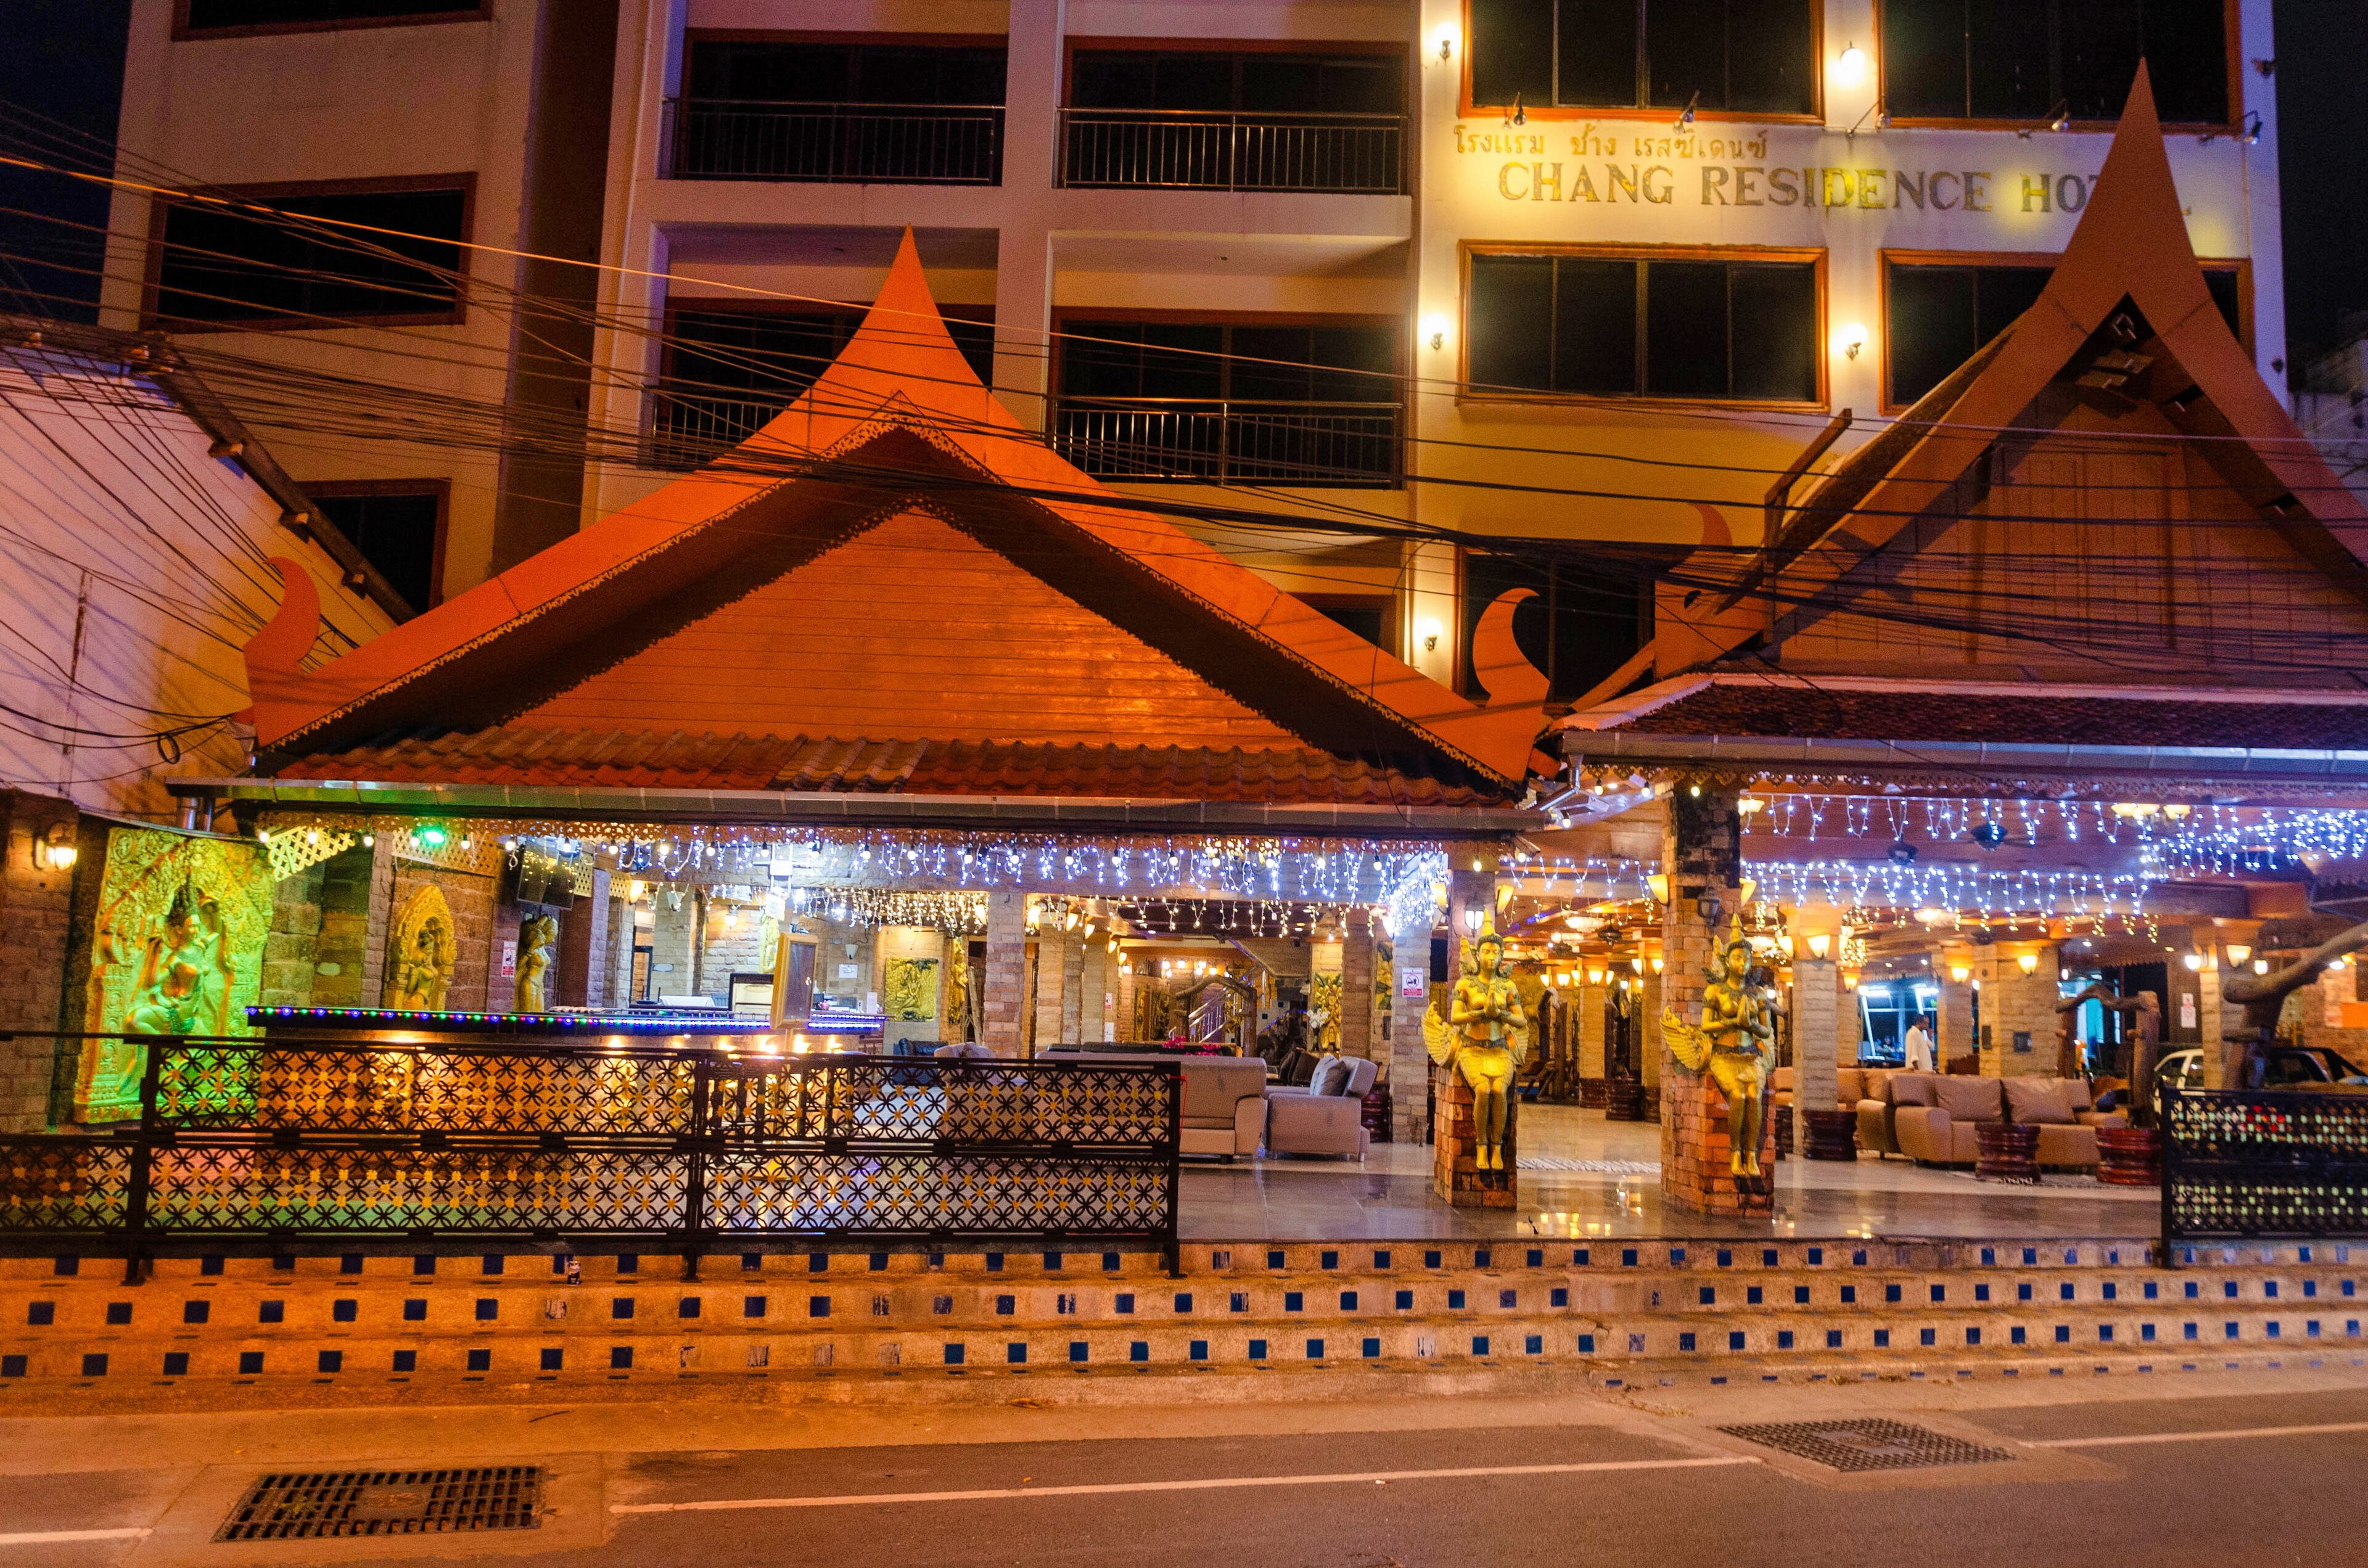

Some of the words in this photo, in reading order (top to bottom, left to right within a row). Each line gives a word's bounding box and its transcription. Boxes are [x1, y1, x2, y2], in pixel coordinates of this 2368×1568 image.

[1453, 125, 1544, 154] โรงแรม
[1569, 123, 1617, 156] ช้าง
[1498, 162, 1674, 204] CHANG
[1700, 166, 1993, 212] RESIDENCE
